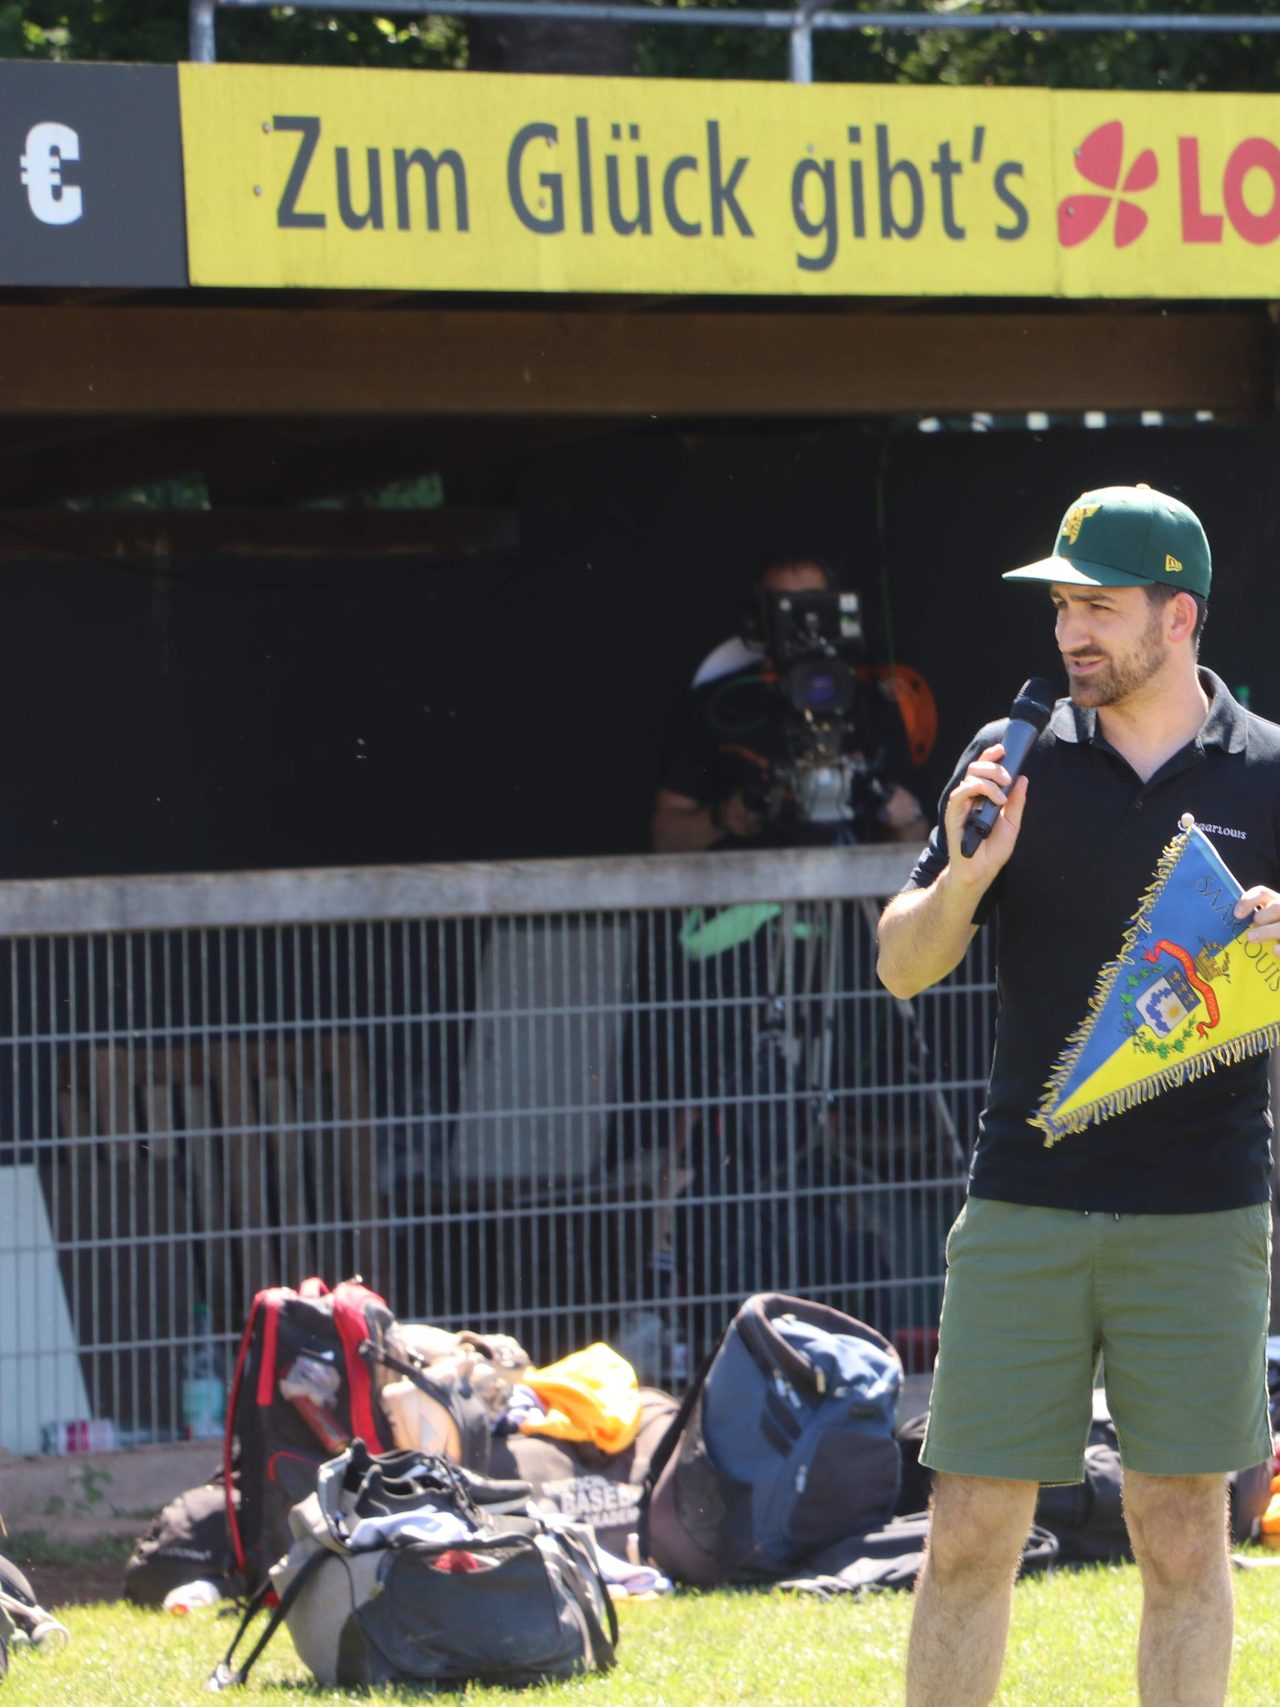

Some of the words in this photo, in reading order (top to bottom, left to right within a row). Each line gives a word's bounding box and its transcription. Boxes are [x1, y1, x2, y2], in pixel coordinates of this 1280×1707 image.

[20, 121, 83, 225] €
[272, 115, 470, 232] Zum
[506, 116, 756, 238] Glück
[791, 123, 1029, 272] gibt's
[559, 1481, 643, 1515] BASEB
